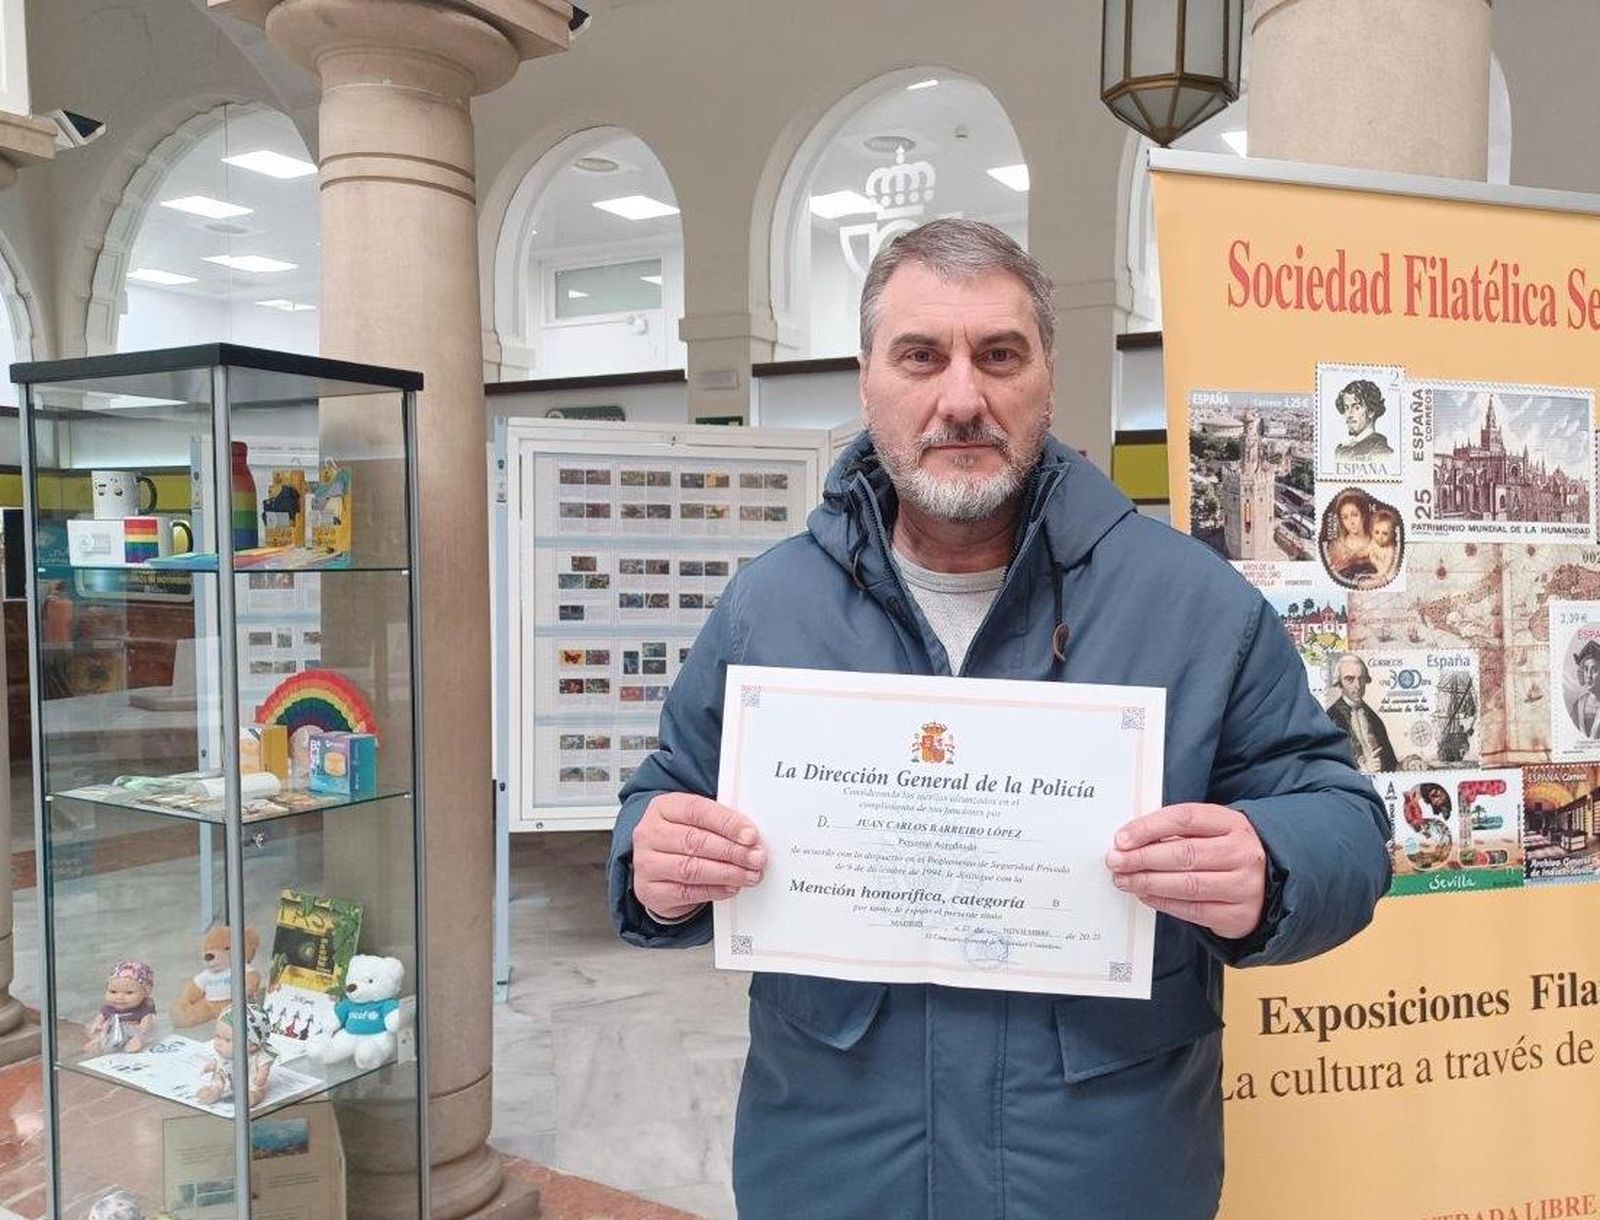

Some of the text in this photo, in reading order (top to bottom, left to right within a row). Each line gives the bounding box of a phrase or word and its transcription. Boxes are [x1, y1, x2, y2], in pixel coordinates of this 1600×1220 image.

[1228, 240, 1392, 315] Sociedad
[1403, 254, 1557, 328] Filatélica
[1192, 392, 1230, 406] ESPAÑA
[1410, 389, 1424, 462] ESPAÑA
[1425, 388, 1433, 442] CORREOS
[1336, 461, 1388, 476] ESPAÑA
[1415, 489, 1432, 520] 25
[1411, 523, 1590, 535] PATRIMONIO MUNDIAL DE LA HUMANIDAD
[1427, 654, 1470, 669] España
[775, 761, 1095, 799] La Dirección General de la Policía
[817, 815, 1022, 839] D. JUAN CARLOS BARREIRO LÓPEZ
[789, 879, 855, 897] Mención
[860, 885, 946, 905] honorífica,
[951, 891, 1025, 909] categoría
[1429, 873, 1476, 890] Sevilla
[1258, 971, 1600, 1042] Exposiciones Fila
[1270, 1057, 1404, 1097] cultura
[1416, 1056, 1433, 1084] a
[1445, 1035, 1543, 1080] través
[1556, 1030, 1594, 1067] de
[1525, 1195, 1597, 1220] LIBRE
